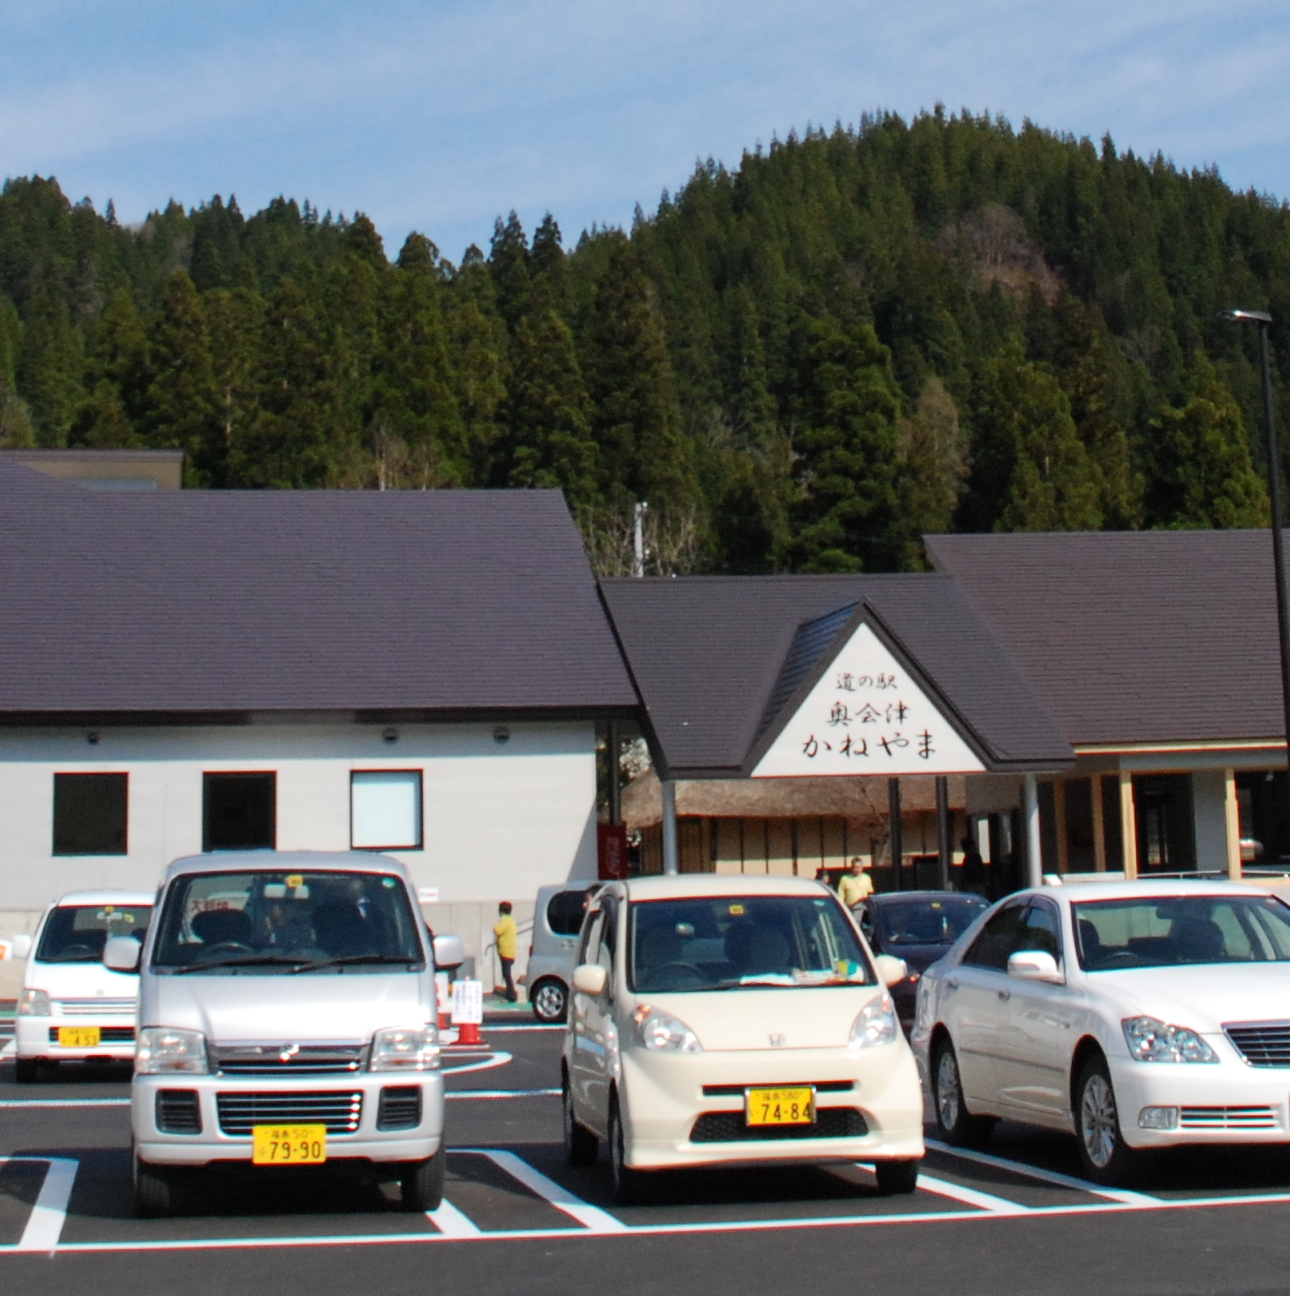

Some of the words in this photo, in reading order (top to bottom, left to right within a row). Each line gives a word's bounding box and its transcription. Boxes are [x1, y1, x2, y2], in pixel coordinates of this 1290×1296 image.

[835, 672, 899, 692] 道の駅
[825, 700, 911, 728] 奥会津
[801, 728, 937, 759] かねやま
[761, 1102, 811, 1122] 74-84
[270, 1140, 321, 1160] 79-90
